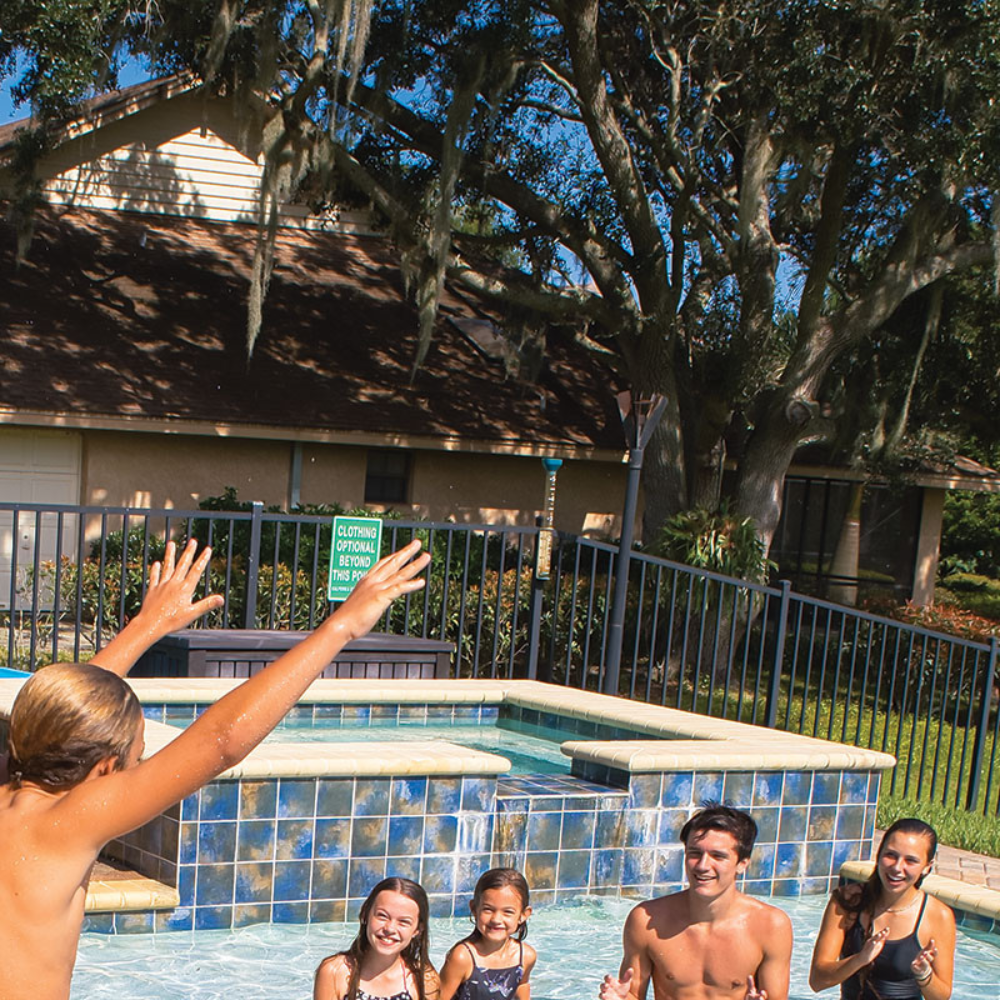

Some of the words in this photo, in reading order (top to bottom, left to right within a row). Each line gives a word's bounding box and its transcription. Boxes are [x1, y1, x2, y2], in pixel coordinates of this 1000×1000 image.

[338, 525, 377, 539] CLOTHING
[336, 540, 375, 553] OPTIONAL
[339, 555, 371, 568] BEYOND
[333, 569, 350, 582] THIS
